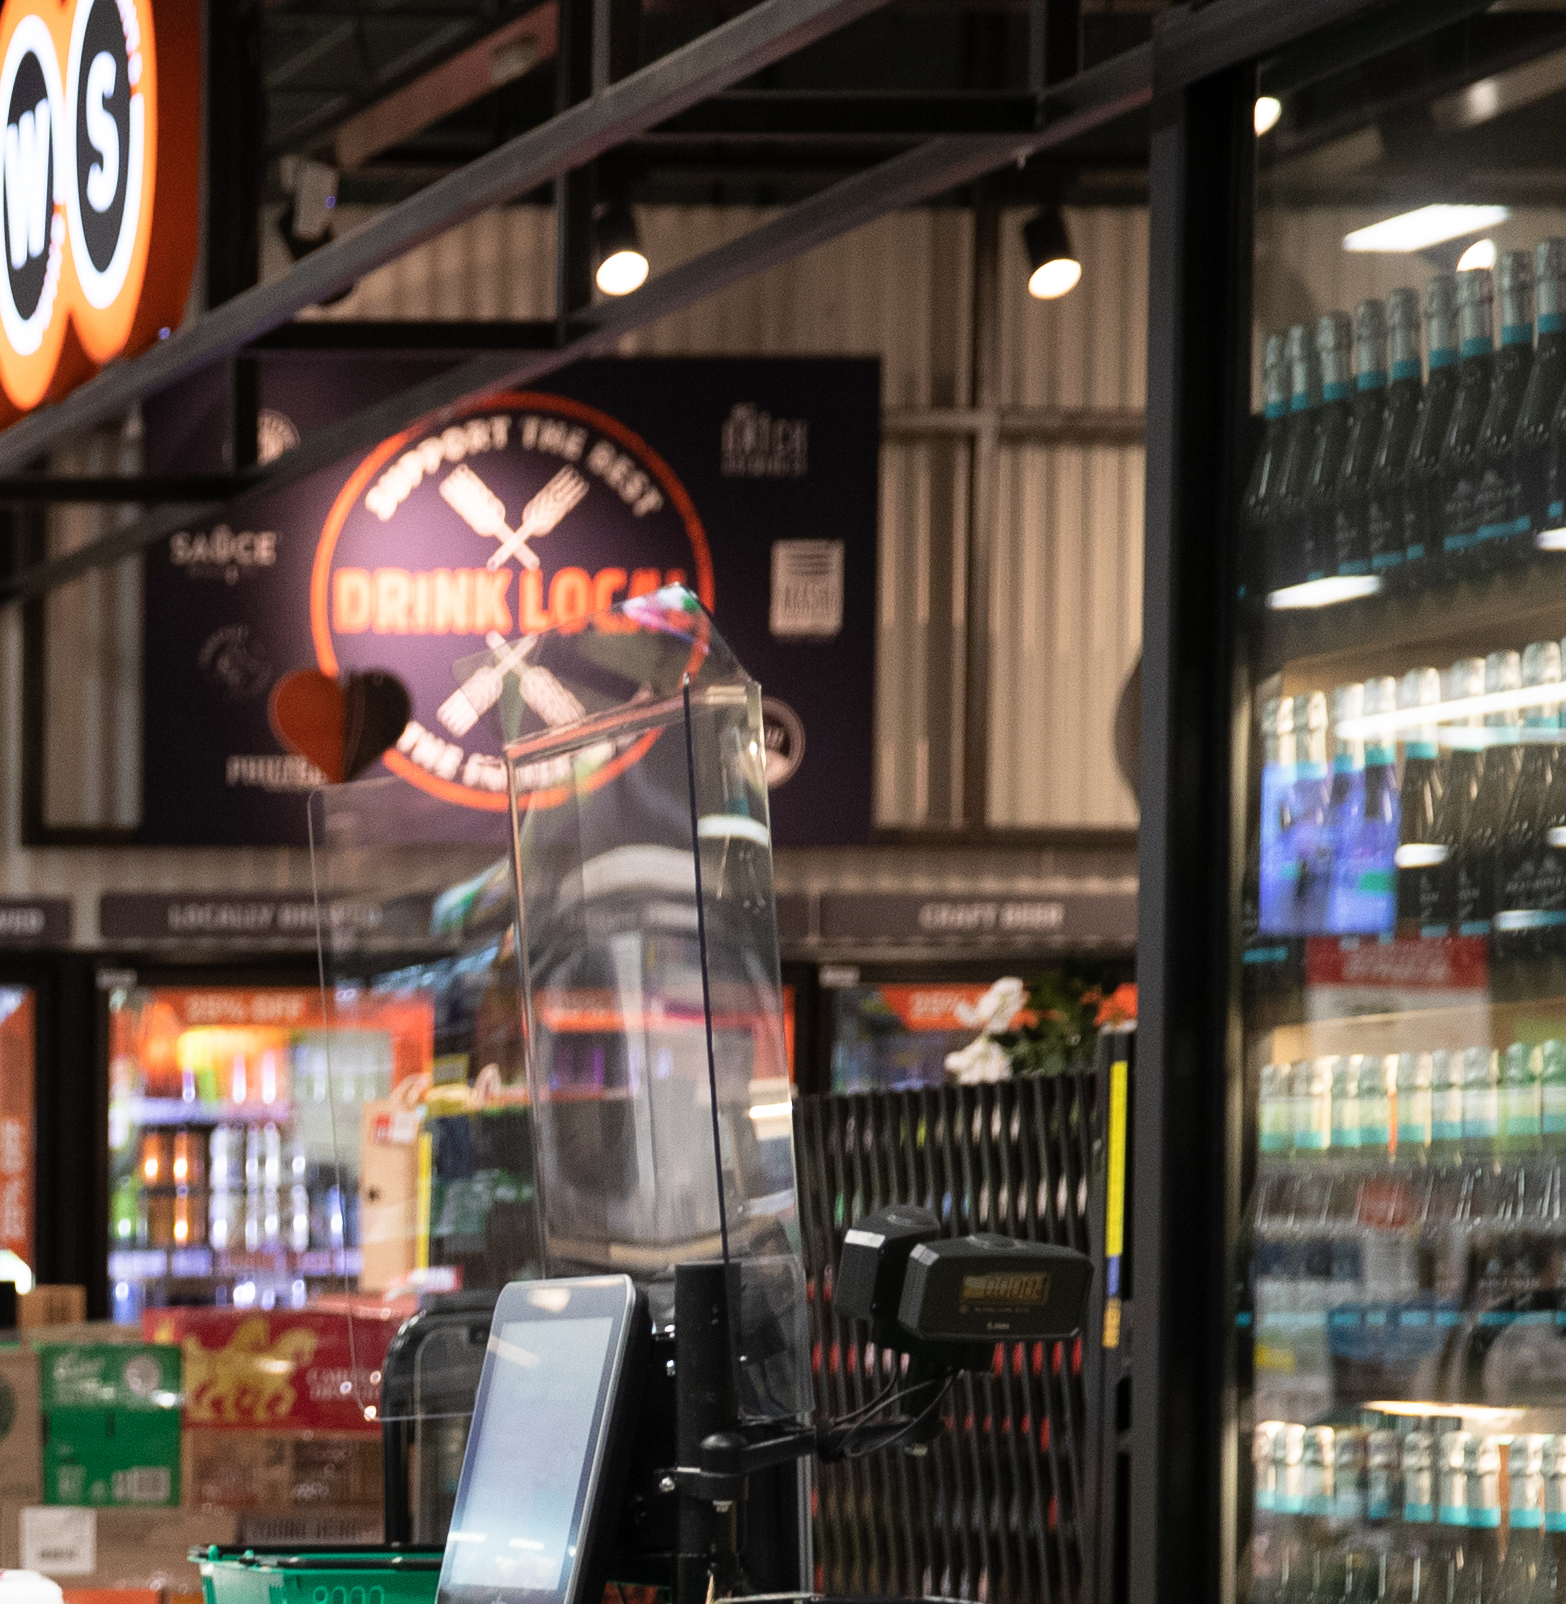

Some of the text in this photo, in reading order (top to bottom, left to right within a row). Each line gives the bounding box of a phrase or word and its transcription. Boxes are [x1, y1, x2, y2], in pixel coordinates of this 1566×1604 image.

[520, 415, 589, 457] THE
[587, 440, 665, 518] BEST
[333, 567, 512, 636] DRINK
[167, 903, 275, 931] LOCALLY
